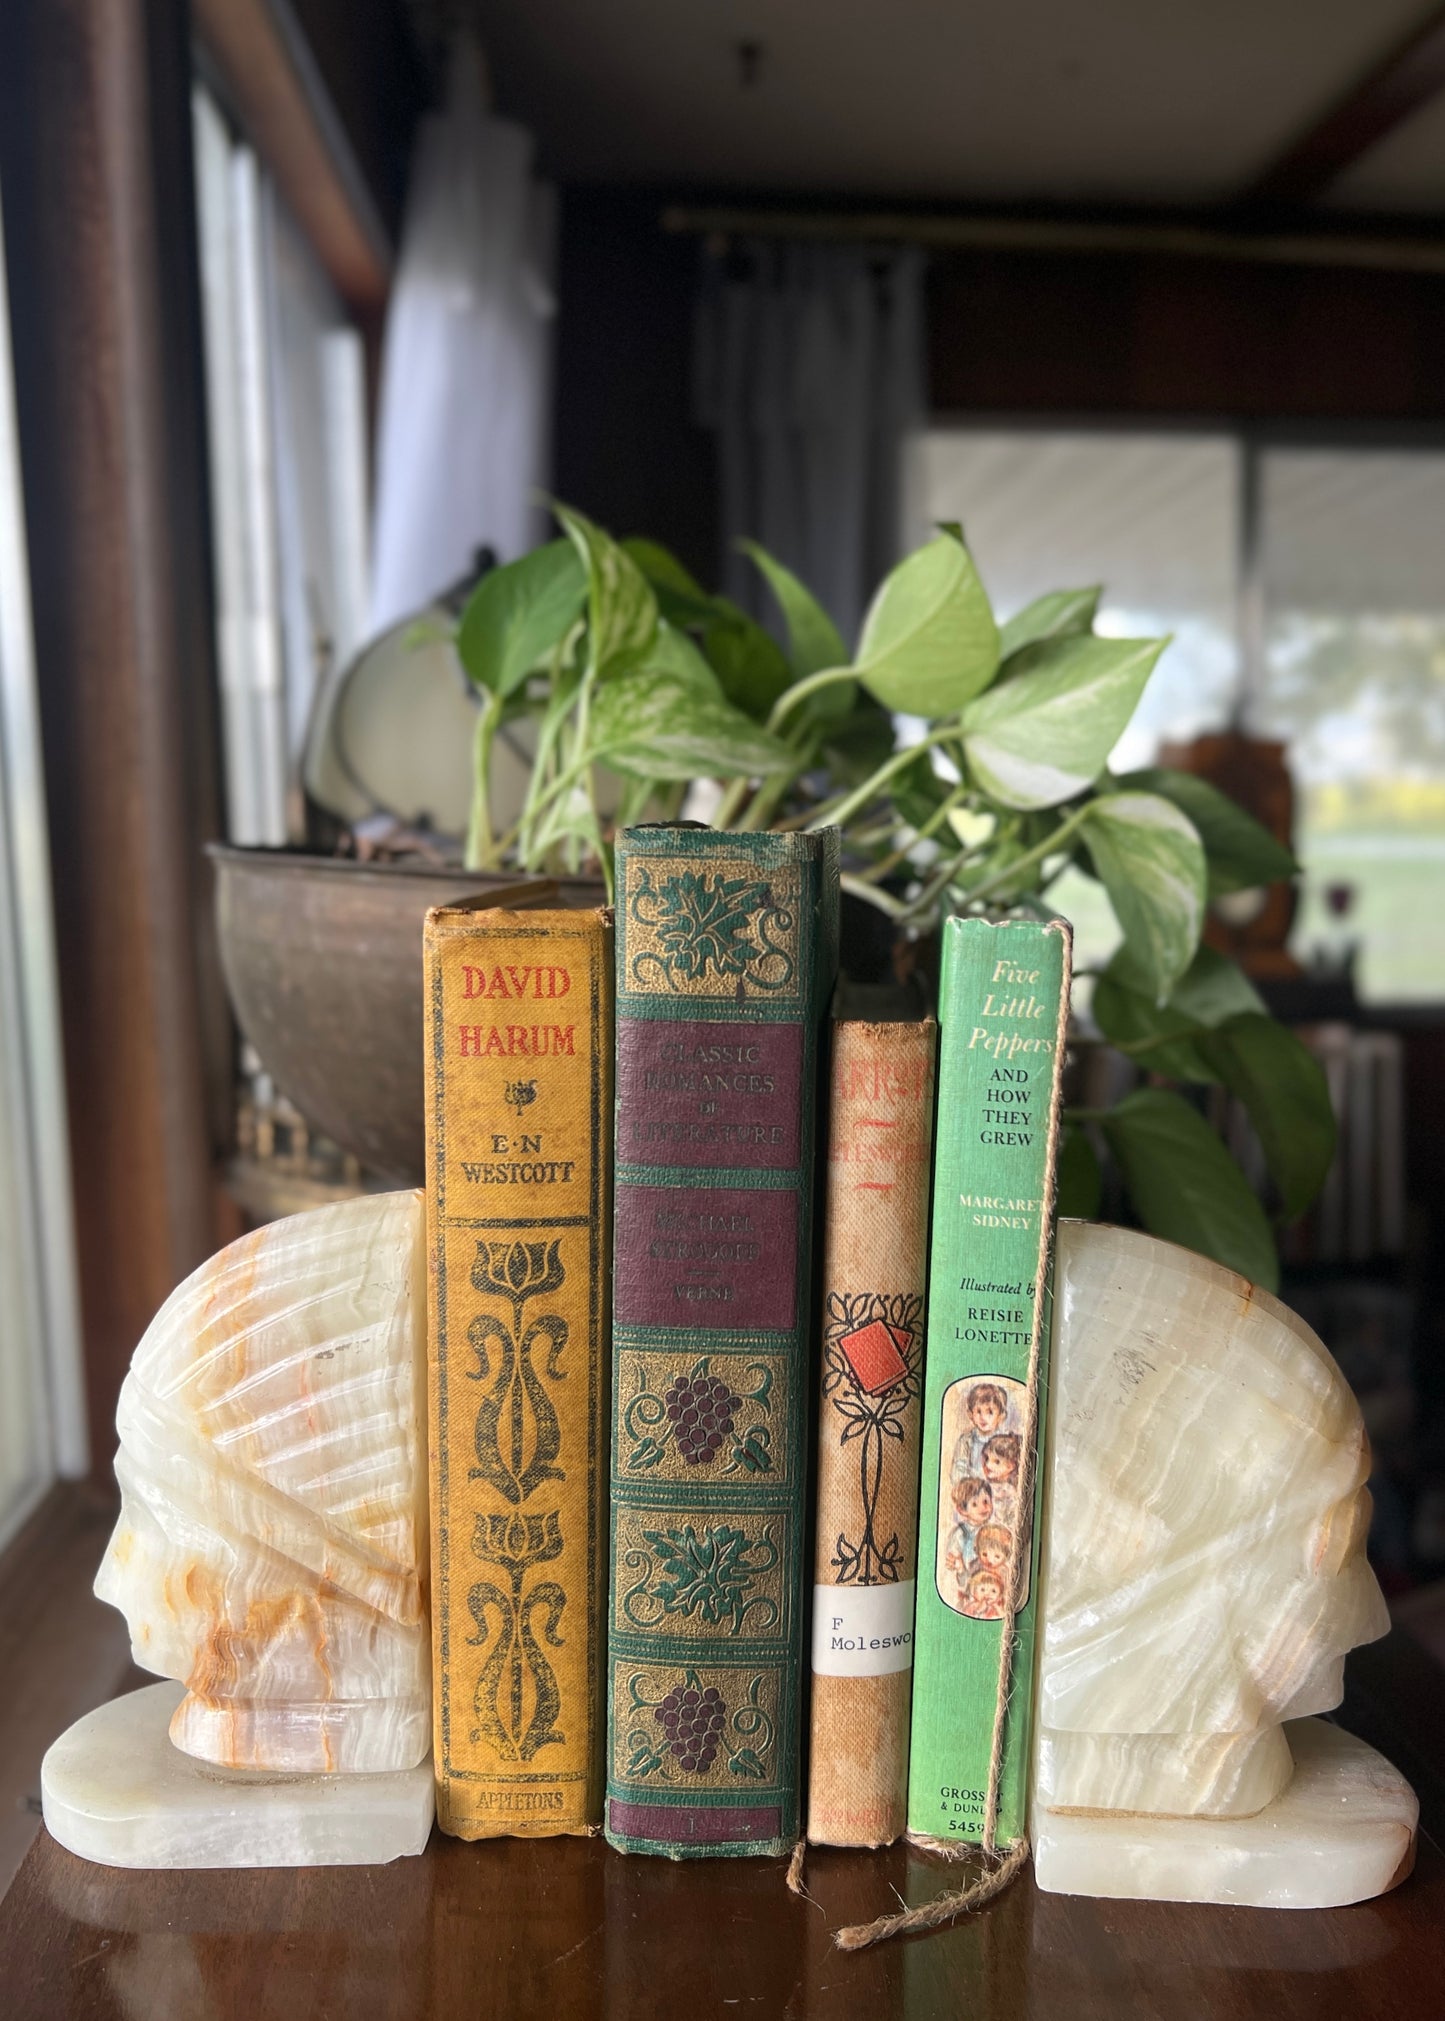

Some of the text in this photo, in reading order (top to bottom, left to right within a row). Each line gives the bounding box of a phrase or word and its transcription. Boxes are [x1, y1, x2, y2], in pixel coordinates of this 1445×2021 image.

[992, 960, 1040, 984] Five
[462, 965, 571, 999] DAVID
[981, 994, 1045, 1019] Little
[459, 1025, 576, 1057] HARUM
[968, 1027, 1054, 1060] Peppers
[661, 1044, 761, 1064] CLASSIC
[645, 1071, 776, 1093] ROMANCES
[990, 1069, 1029, 1083] AND
[987, 1090, 1031, 1104] HOW
[982, 1110, 1032, 1125] THEY
[632, 1121, 783, 1144] LITERATURE
[980, 1131, 1034, 1146] GREW
[461, 1161, 575, 1184] WESTCOTT
[972, 1215, 1032, 1230] SIDNEY
[960, 1278, 1022, 1295] Illustrated
[967, 1307, 1024, 1323] REISIE
[955, 1327, 1033, 1345] LONETTE
[831, 1617, 844, 1630] F
[831, 1632, 912, 1650] Moleswo
[476, 1791, 564, 1811] APPLETONS
[940, 1802, 948, 1811] &
